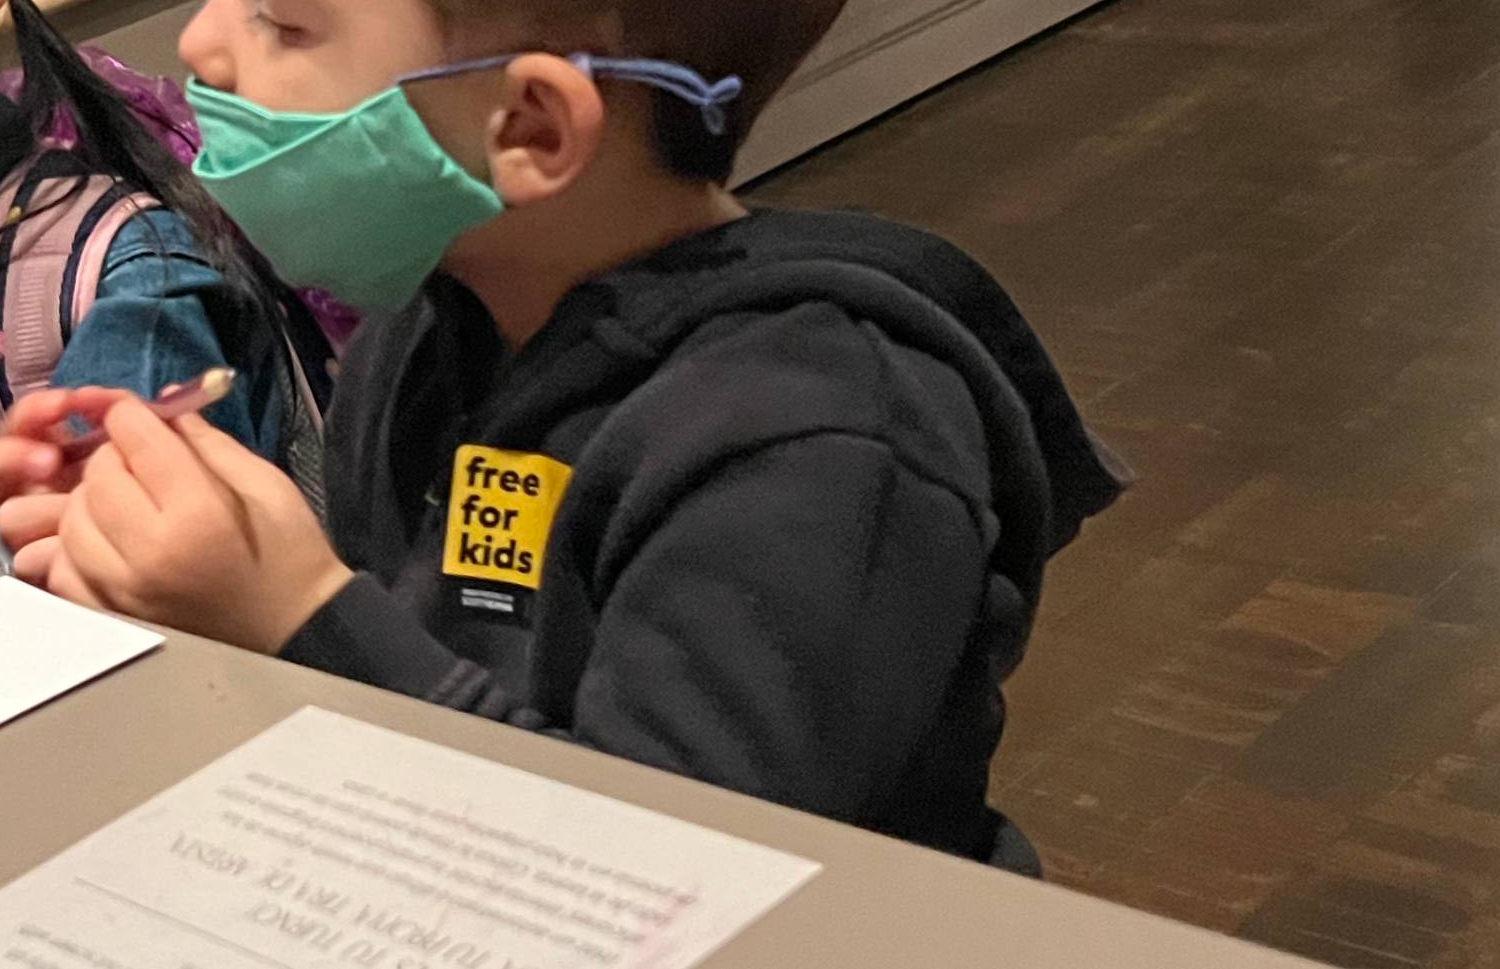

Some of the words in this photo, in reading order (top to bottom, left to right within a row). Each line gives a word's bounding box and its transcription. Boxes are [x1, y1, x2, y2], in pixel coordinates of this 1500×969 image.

[466, 455, 541, 497] free
[461, 494, 520, 531] for
[459, 532, 533, 574] kids
